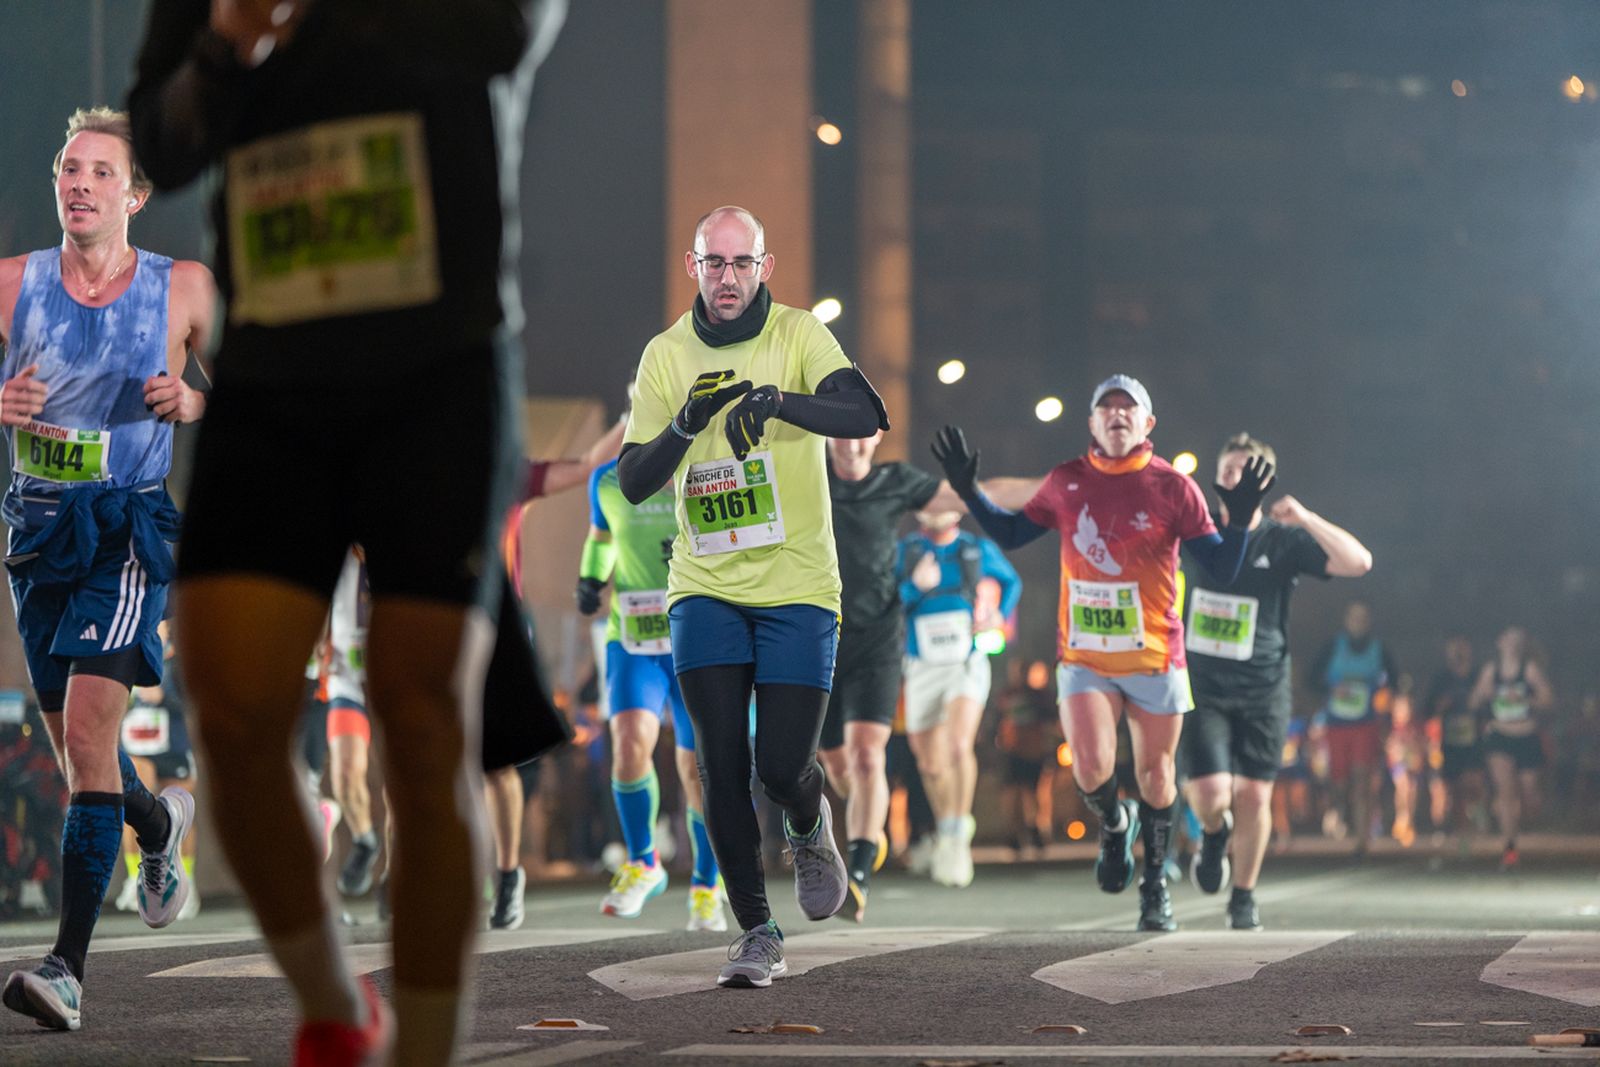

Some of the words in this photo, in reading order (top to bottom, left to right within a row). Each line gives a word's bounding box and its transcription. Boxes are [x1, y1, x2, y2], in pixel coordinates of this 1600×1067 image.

[30, 436, 84, 472] 6144
[693, 470, 722, 483] NOCHE
[723, 468, 735, 478] DE
[687, 485, 704, 497] SAN
[705, 478, 737, 494] ANTÓN
[699, 488, 758, 523] 3161
[1086, 543, 1106, 565] 43
[636, 614, 669, 636] 105
[1082, 606, 1127, 630] 9134
